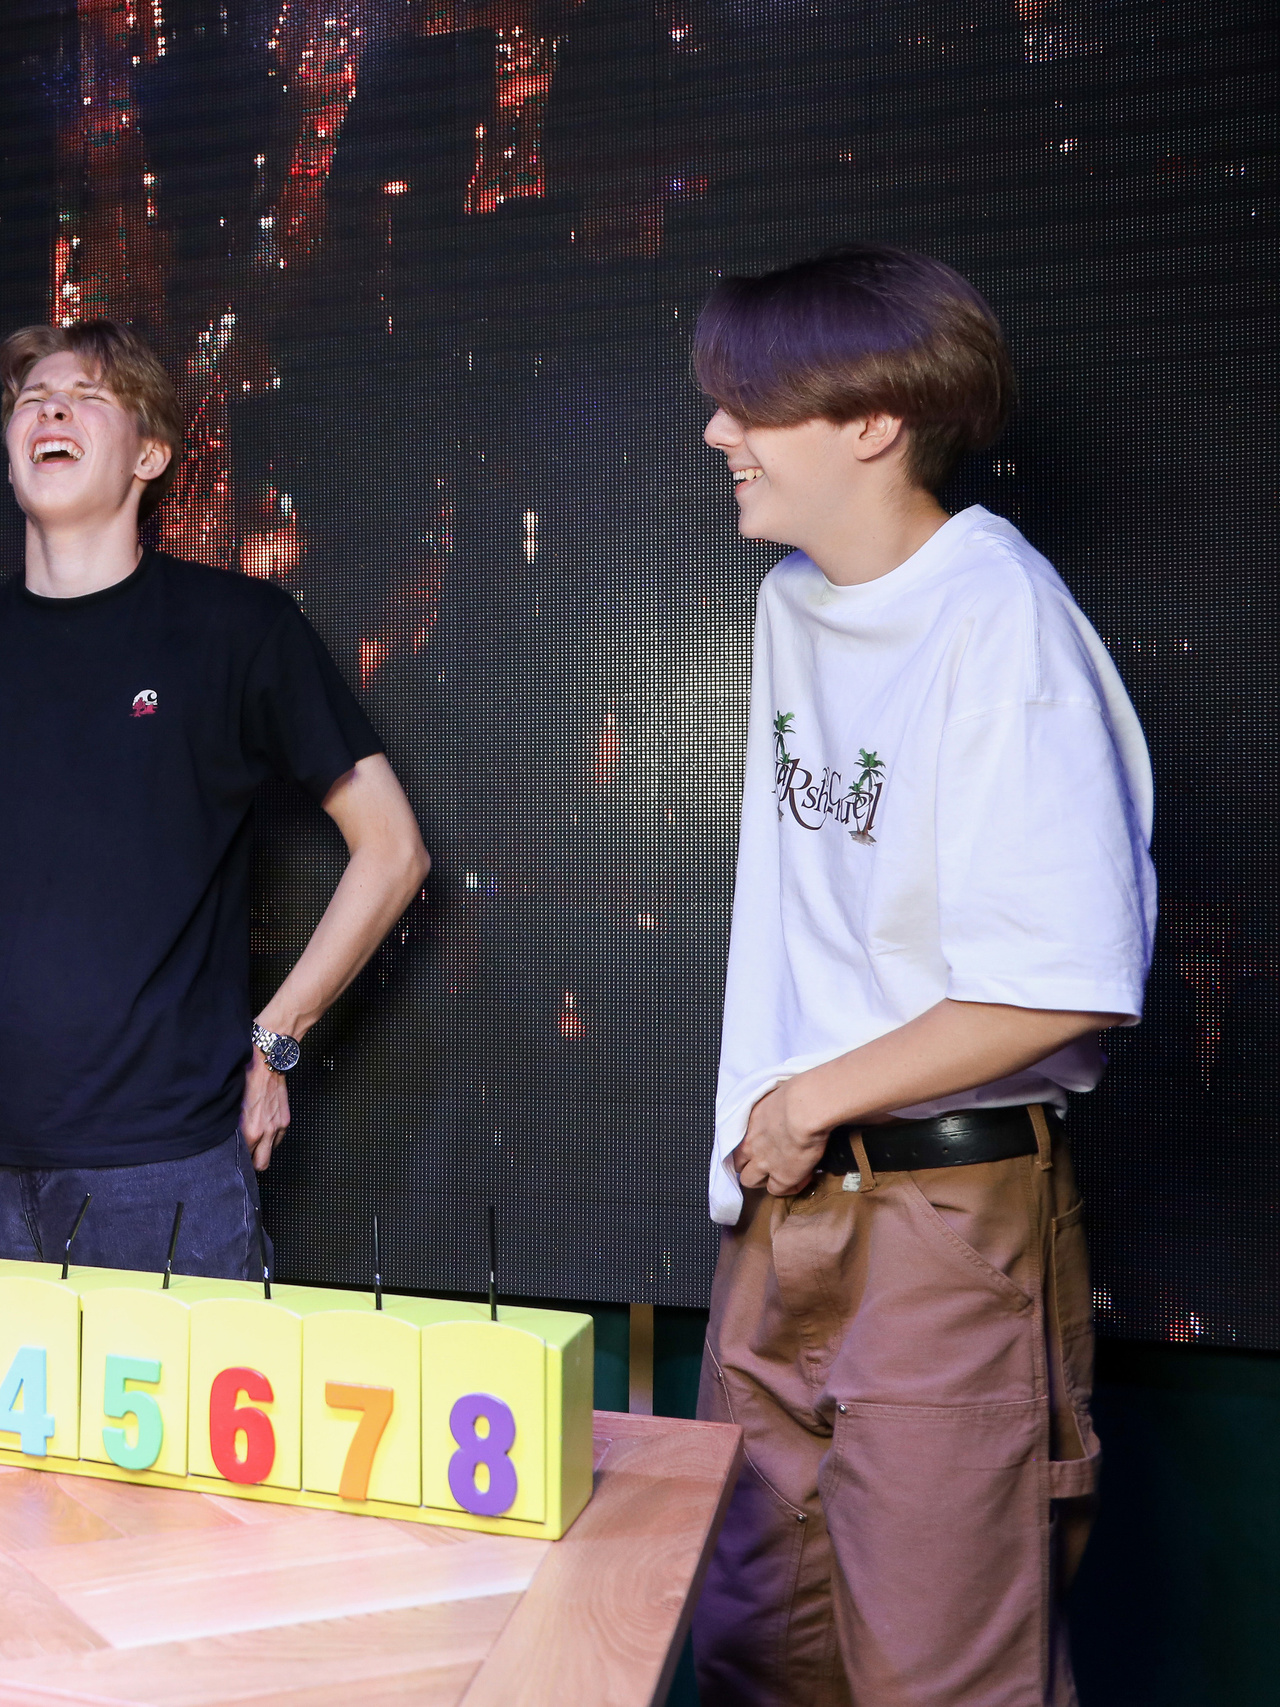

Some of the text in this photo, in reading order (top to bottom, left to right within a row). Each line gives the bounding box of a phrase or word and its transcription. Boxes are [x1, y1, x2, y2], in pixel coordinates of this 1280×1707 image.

[102, 1354, 163, 1470] 5
[209, 1366, 276, 1484] 6
[325, 1380, 394, 1501] 7
[448, 1391, 518, 1515] 8
